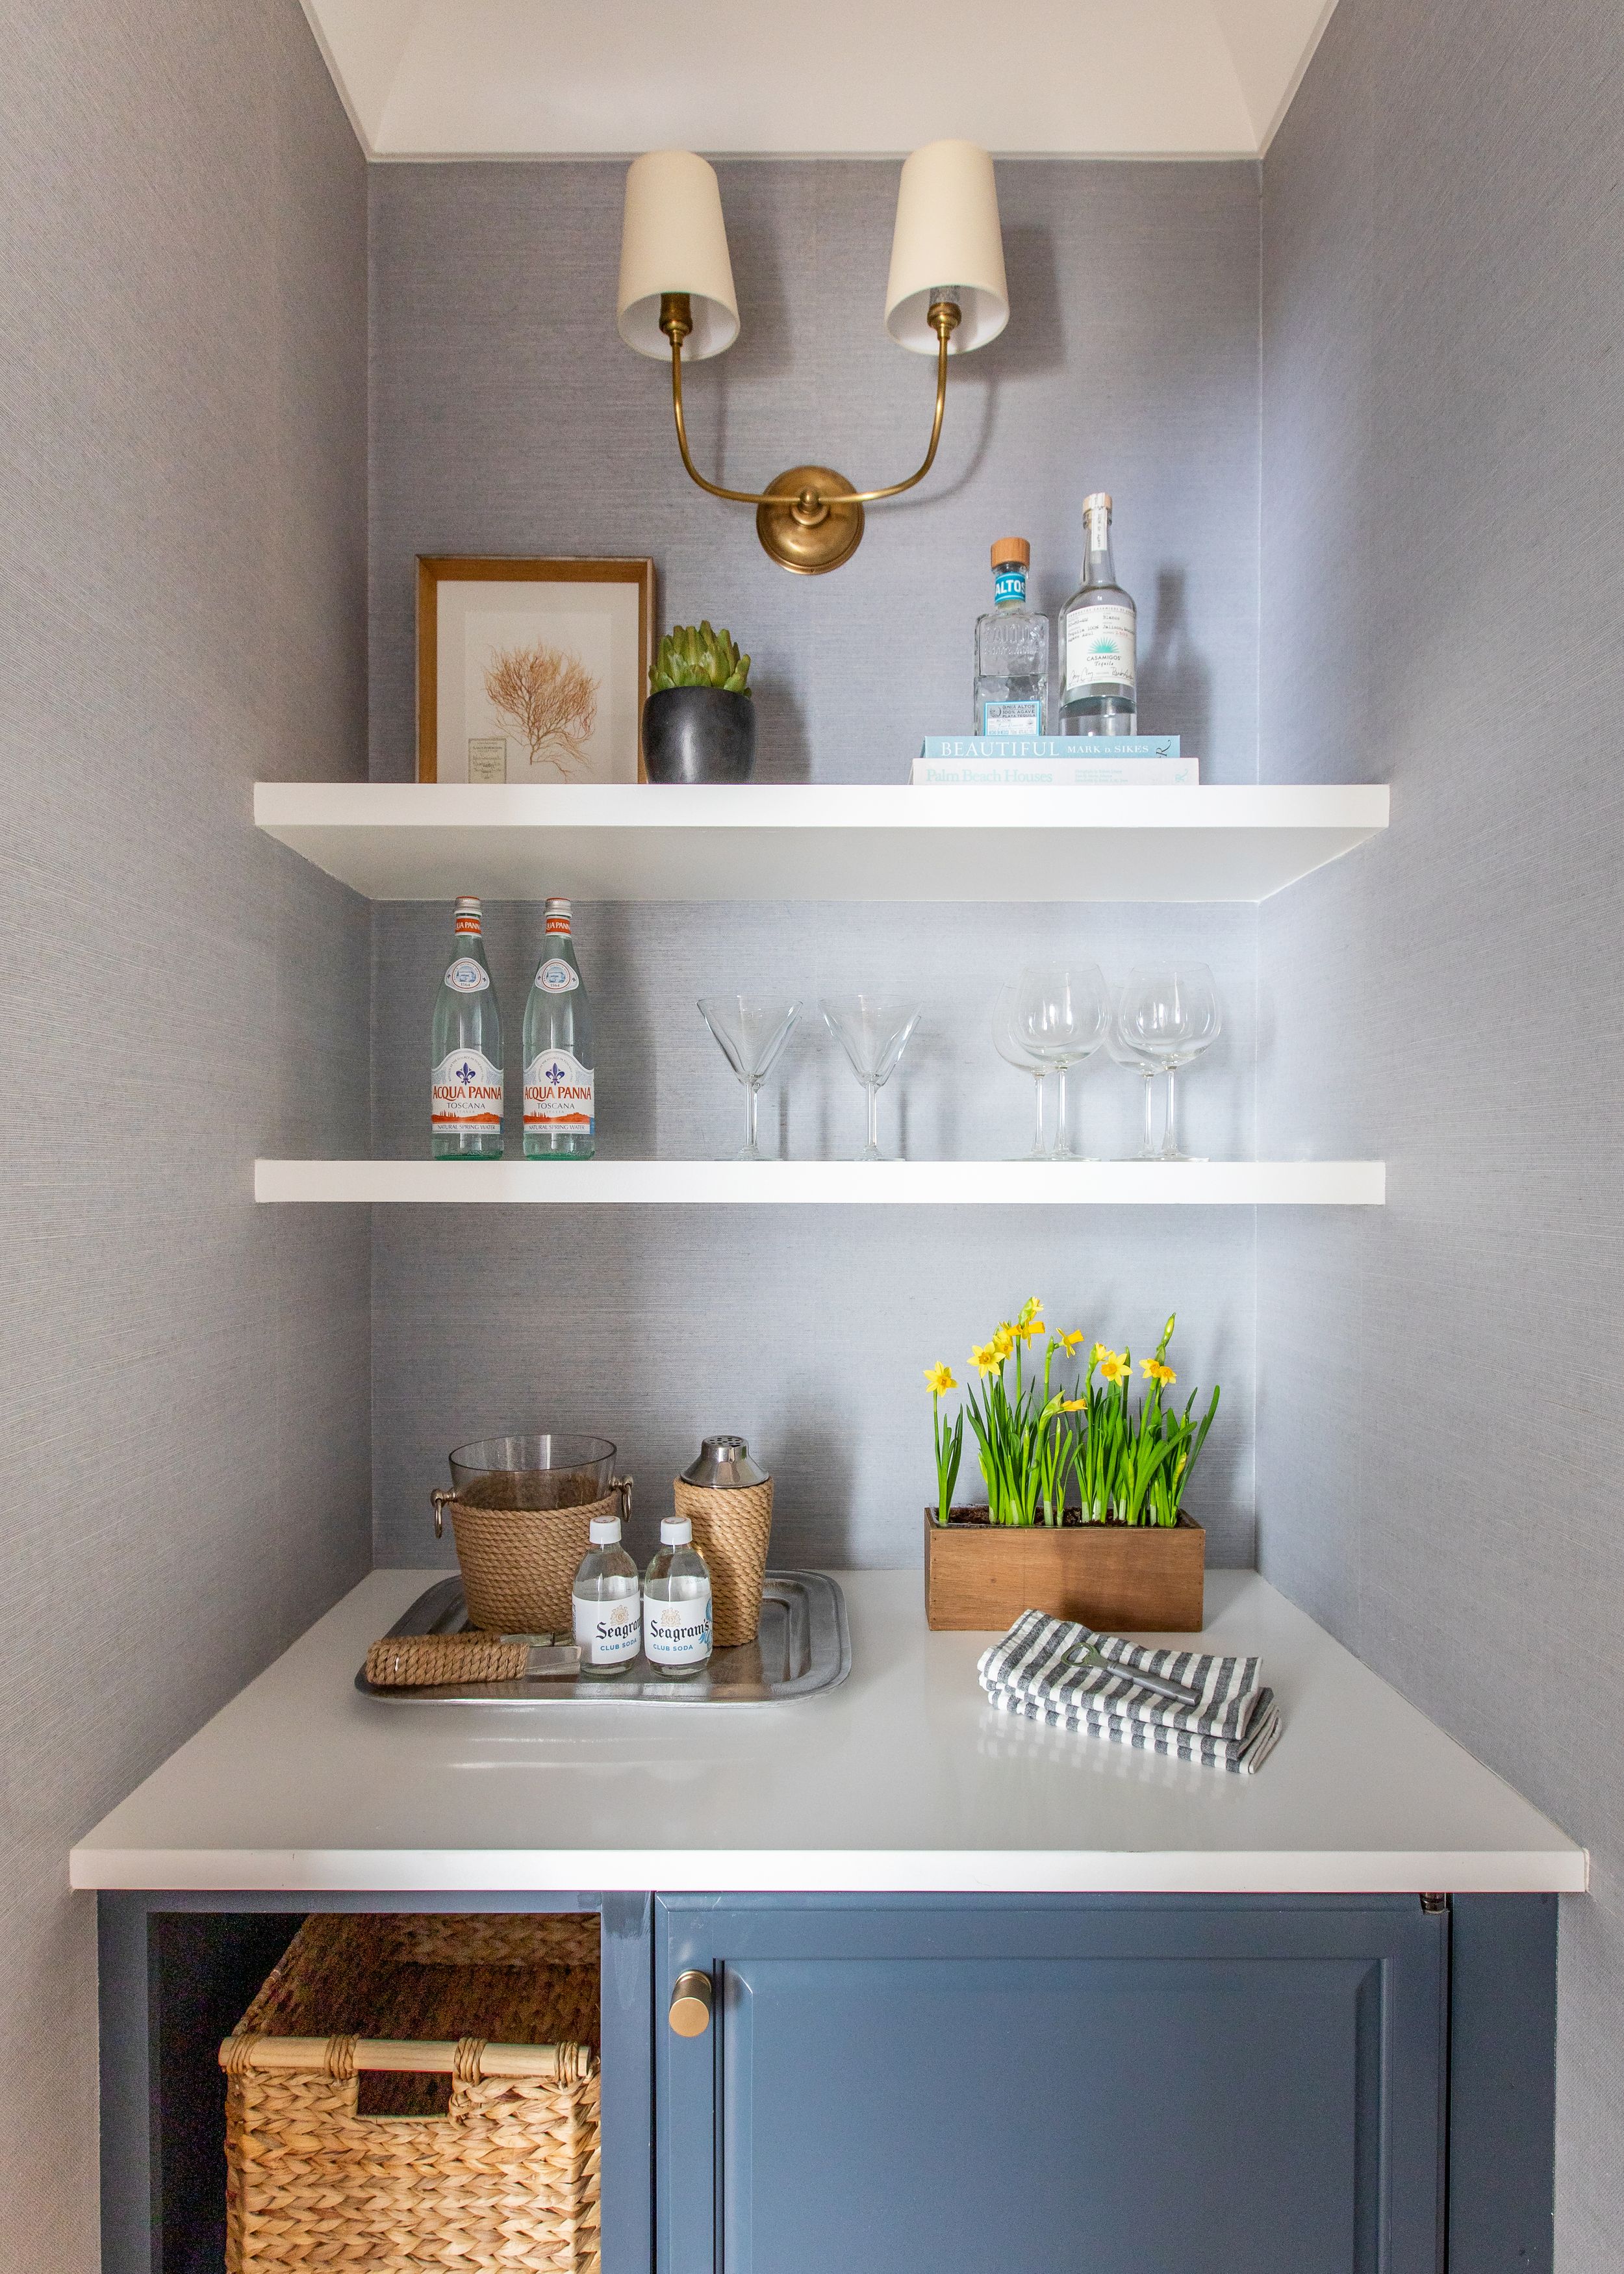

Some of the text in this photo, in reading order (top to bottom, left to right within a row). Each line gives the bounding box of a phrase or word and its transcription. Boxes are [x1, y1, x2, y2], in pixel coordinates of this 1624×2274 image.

[995, 579, 1026, 596] ALTOS
[941, 741, 1059, 757] BEAUTIFUL
[926, 768, 1053, 783] Palm Beach Houses
[433, 1086, 502, 1101] ACQUA PANNA
[524, 1086, 592, 1102] ACQUA PANNA
[650, 1618, 710, 1642] Seagram's
[622, 1638, 637, 1648] SODA
